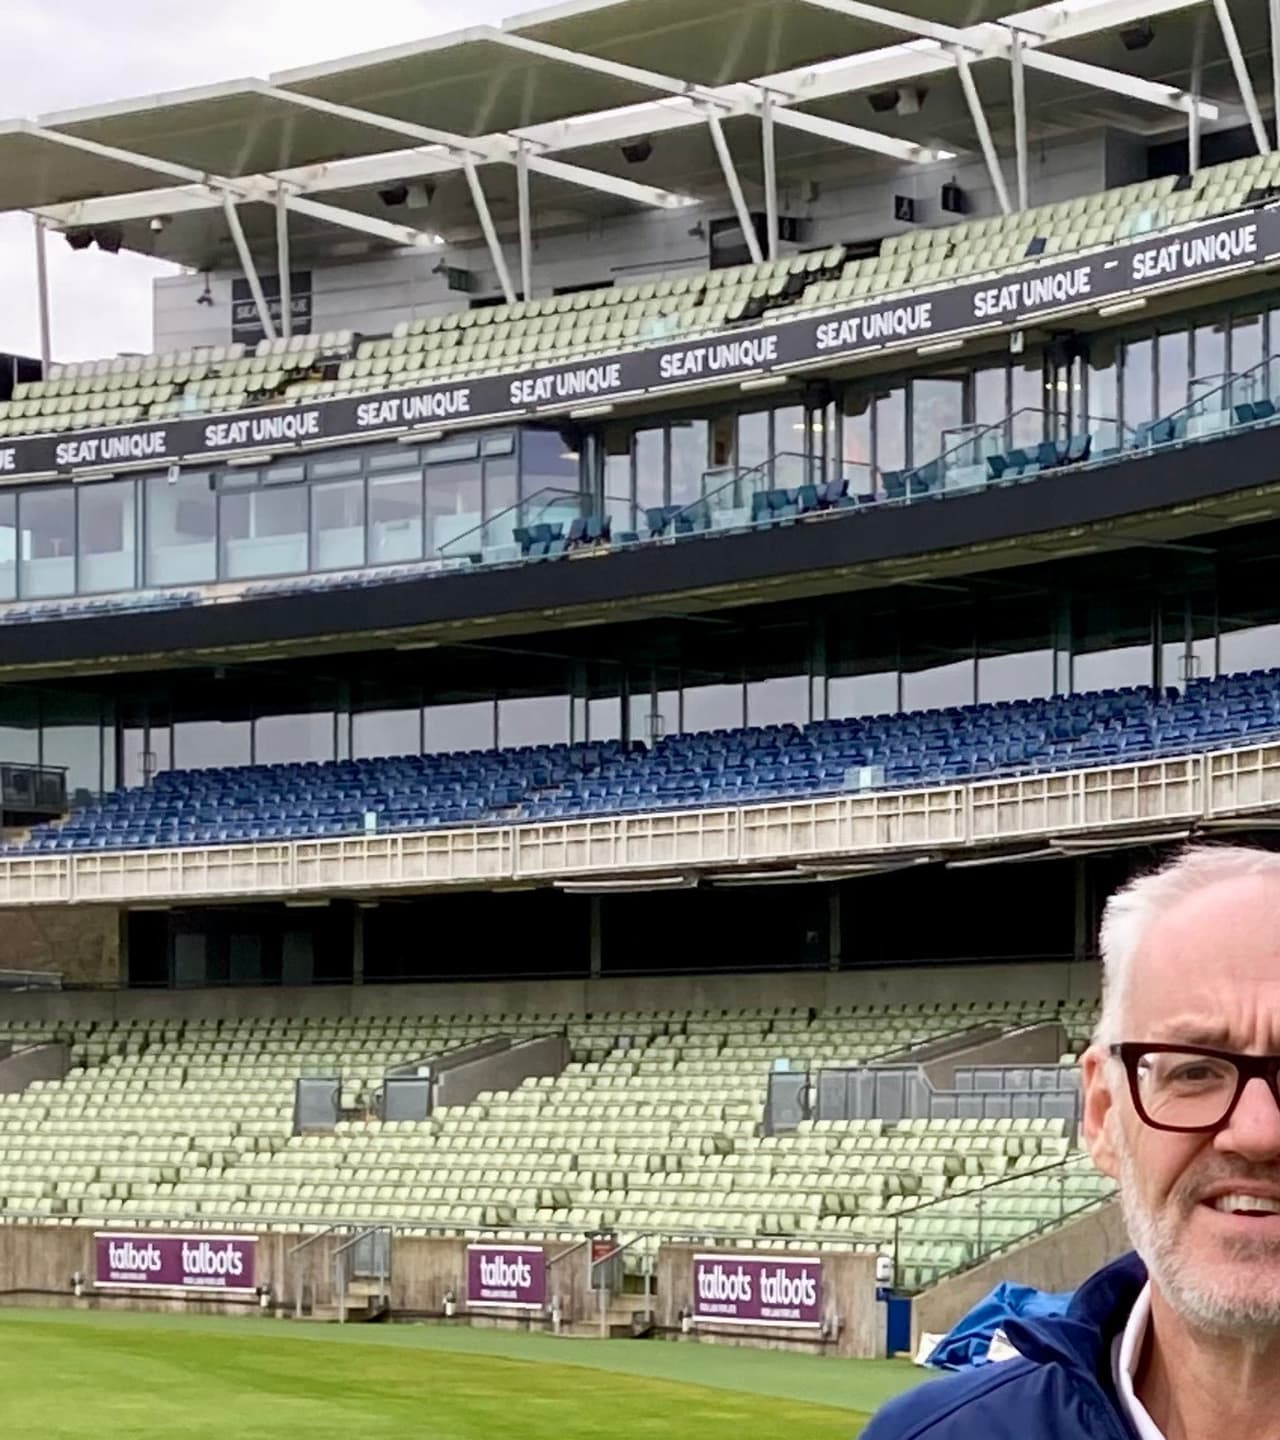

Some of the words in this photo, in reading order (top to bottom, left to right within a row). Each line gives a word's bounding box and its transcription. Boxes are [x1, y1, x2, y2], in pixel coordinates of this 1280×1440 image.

[1133, 244, 1182, 281] SEAT
[1182, 224, 1257, 268] UNIQUE
[974, 283, 1021, 318] SEAT
[1023, 267, 1091, 307] UNIQUE
[816, 318, 861, 349] SEAT
[862, 303, 932, 339] UNIQUE
[660, 350, 709, 378] SEAT
[708, 335, 778, 370] UNIQUE
[511, 376, 554, 404] SEAT
[556, 363, 621, 397] UNIQUE
[357, 400, 400, 426] SEAT
[402, 389, 470, 420] UNIQUE
[56, 439, 99, 465] SEAT
[101, 431, 166, 459] UNIQUE
[205, 421, 250, 447] SEAT
[252, 411, 318, 441] UNIQUE
[109, 1242, 161, 1271] talbots
[181, 1242, 243, 1275] talbots
[480, 1255, 531, 1288] talbots
[698, 1264, 752, 1302] talbots
[760, 1268, 816, 1306] talbots
